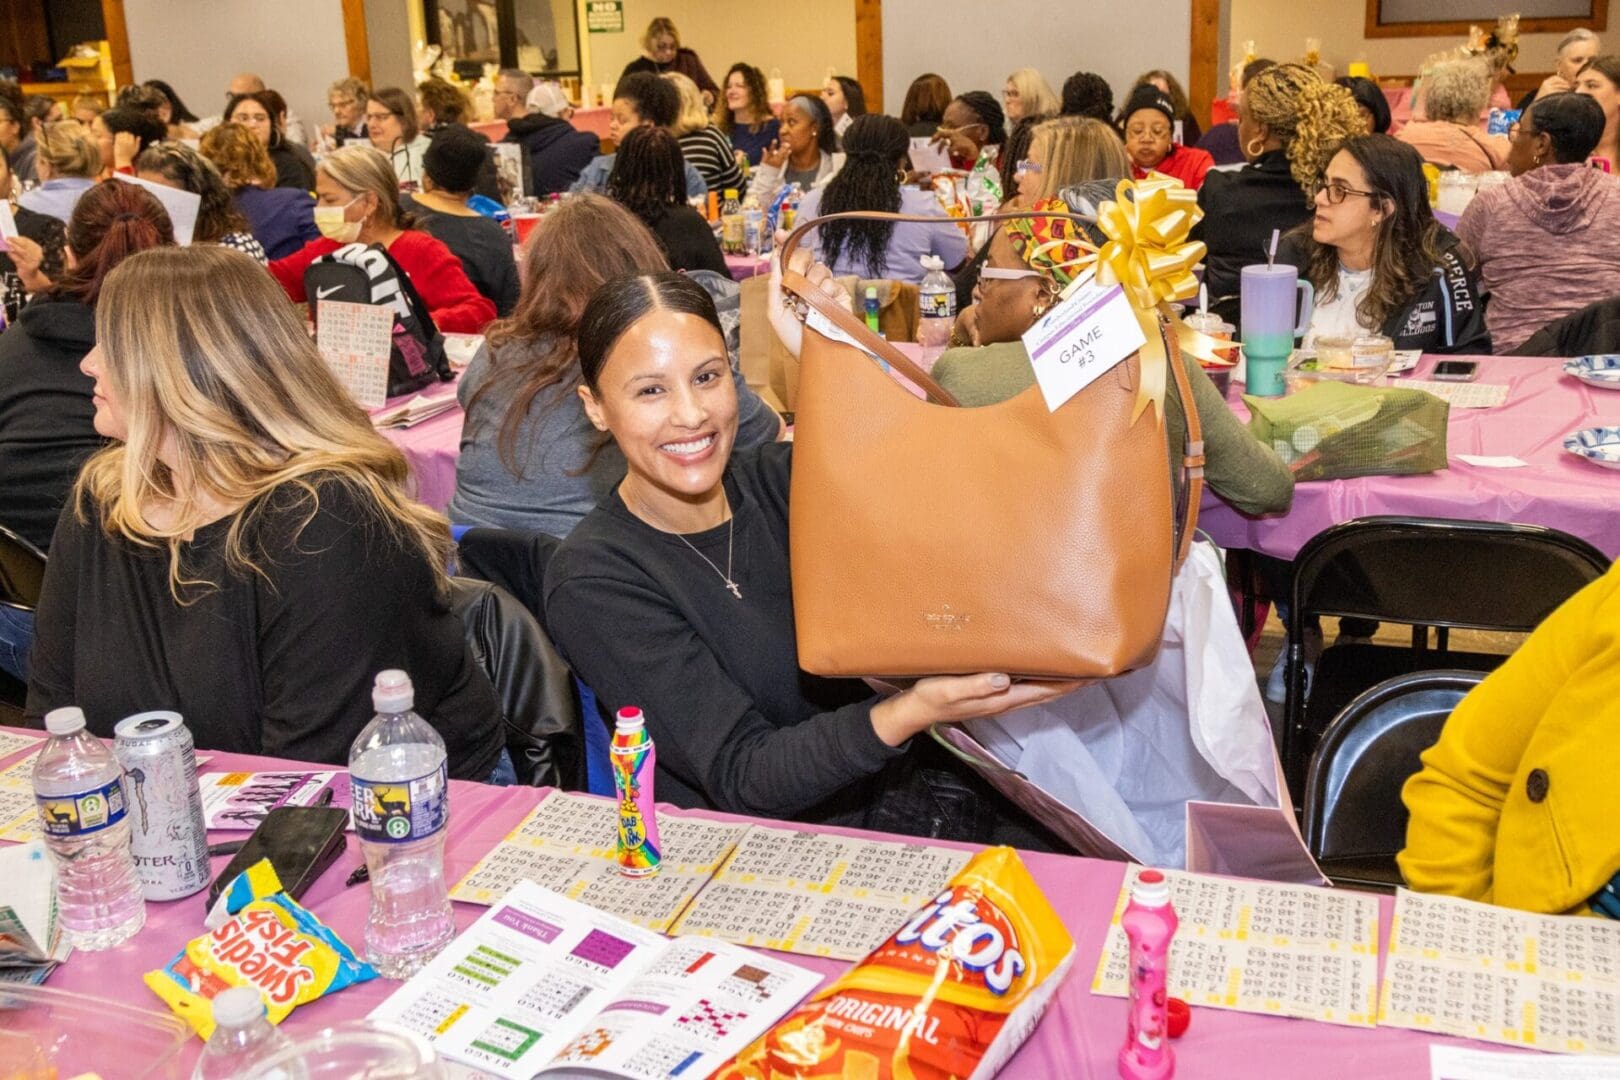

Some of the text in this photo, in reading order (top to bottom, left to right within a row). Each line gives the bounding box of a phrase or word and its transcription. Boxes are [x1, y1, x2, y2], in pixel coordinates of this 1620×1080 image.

[592, 2, 617, 12] NO
[1444, 252, 1474, 311] PIERCE
[1059, 325, 1103, 364] GAME
[1078, 350, 1096, 368] #3
[544, 805, 560, 813] 62
[621, 816, 637, 828] DAB
[625, 832, 641, 846] INK
[705, 894, 722, 902] 73
[774, 892, 791, 900] 28
[699, 901, 714, 910] 75
[747, 898, 763, 906] 32
[1406, 900, 1423, 908] 66
[691, 910, 709, 918] 63
[1454, 906, 1471, 914] 36
[685, 919, 702, 927] 66
[776, 921, 792, 929] 10
[1403, 917, 1421, 927] 69
[1452, 916, 1470, 925] 40
[500, 912, 549, 939] Thank You
[748, 927, 766, 935] 29
[1401, 927, 1419, 936] 62
[247, 910, 311, 968] Fish
[1451, 935, 1469, 943] 43
[564, 955, 610, 976] BINGO
[1323, 957, 1341, 965] 28
[1245, 969, 1263, 977] 70
[1322, 966, 1341, 975] 29
[447, 971, 491, 993] BINGO
[1321, 977, 1339, 986] 23
[1296, 984, 1312, 993] 31
[1320, 989, 1339, 997] 20
[1294, 995, 1311, 1003] 37
[1321, 999, 1339, 1008] 27
[516, 999, 563, 1021] BINGO
[825, 996, 940, 1046] ORIGINAL
[464, 1048, 518, 1071] BINGO
